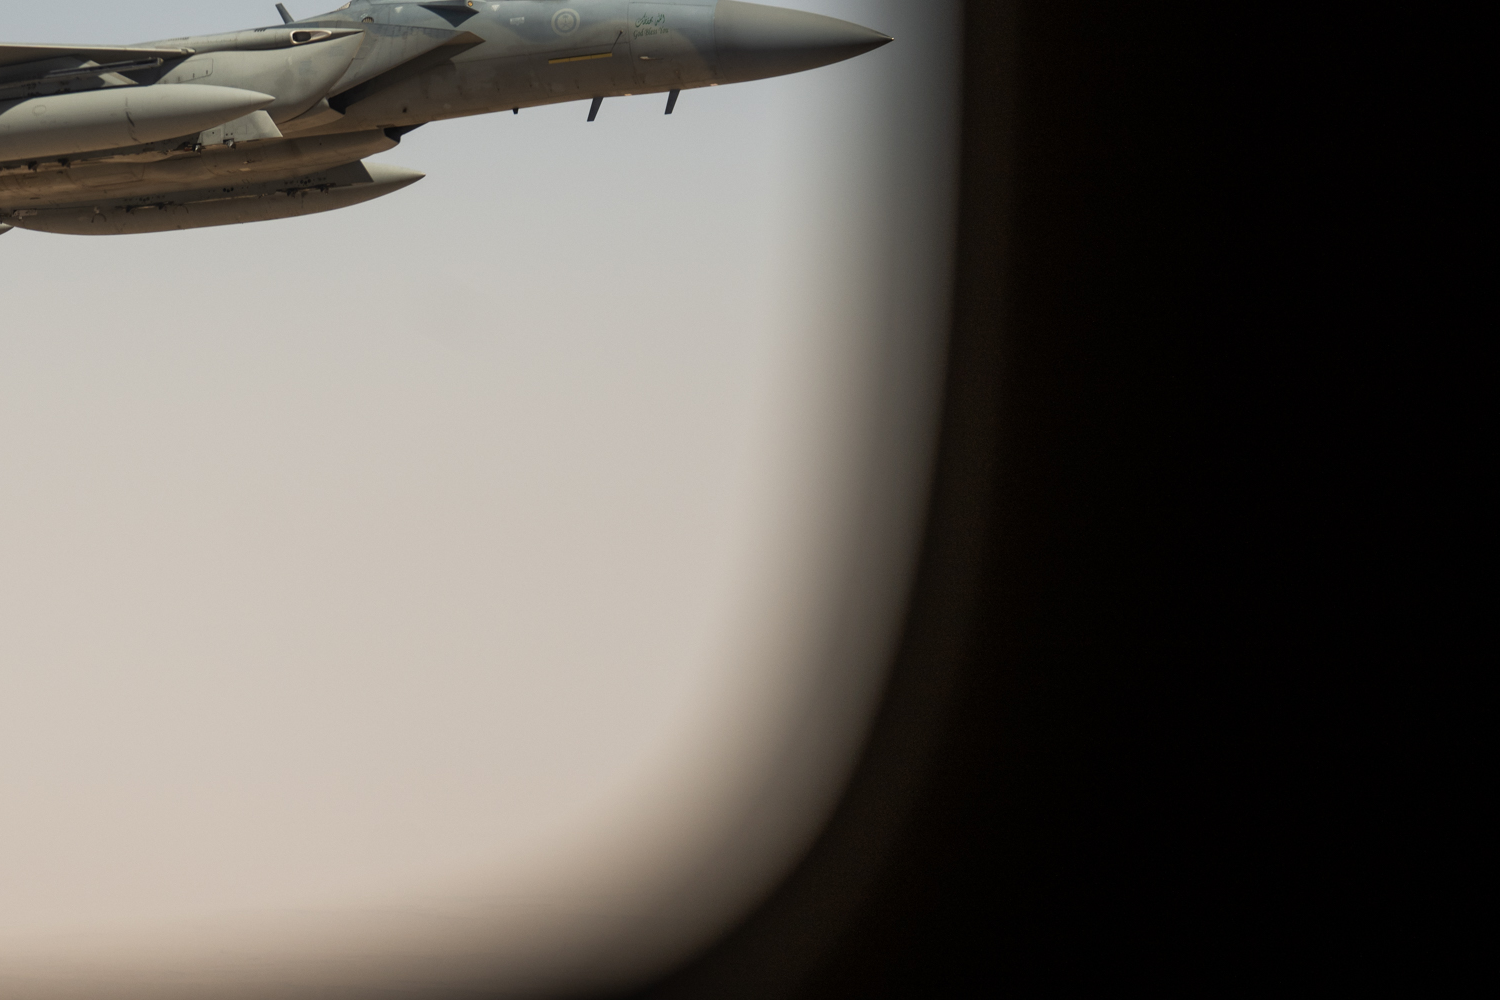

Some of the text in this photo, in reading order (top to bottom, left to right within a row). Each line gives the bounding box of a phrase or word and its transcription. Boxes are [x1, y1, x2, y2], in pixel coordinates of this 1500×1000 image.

[633, 26, 669, 40] God Bless You
